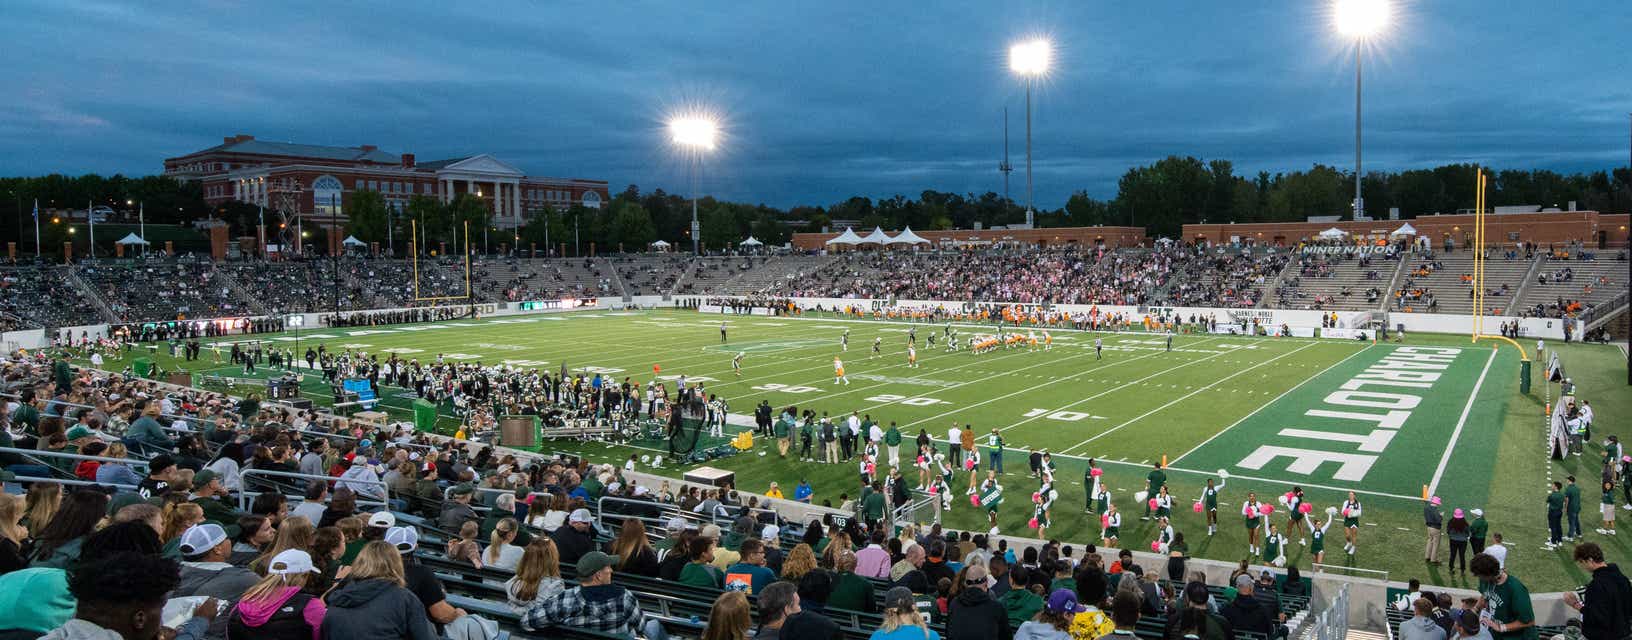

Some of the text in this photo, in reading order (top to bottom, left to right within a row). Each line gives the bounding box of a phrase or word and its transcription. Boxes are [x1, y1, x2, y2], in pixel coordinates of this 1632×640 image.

[1303, 245, 1396, 254] NINER NATION
[864, 394, 941, 406] 20
[1022, 408, 1089, 421] 10
[1235, 346, 1462, 481] CHARLOTTE
[833, 517, 846, 527] 103
